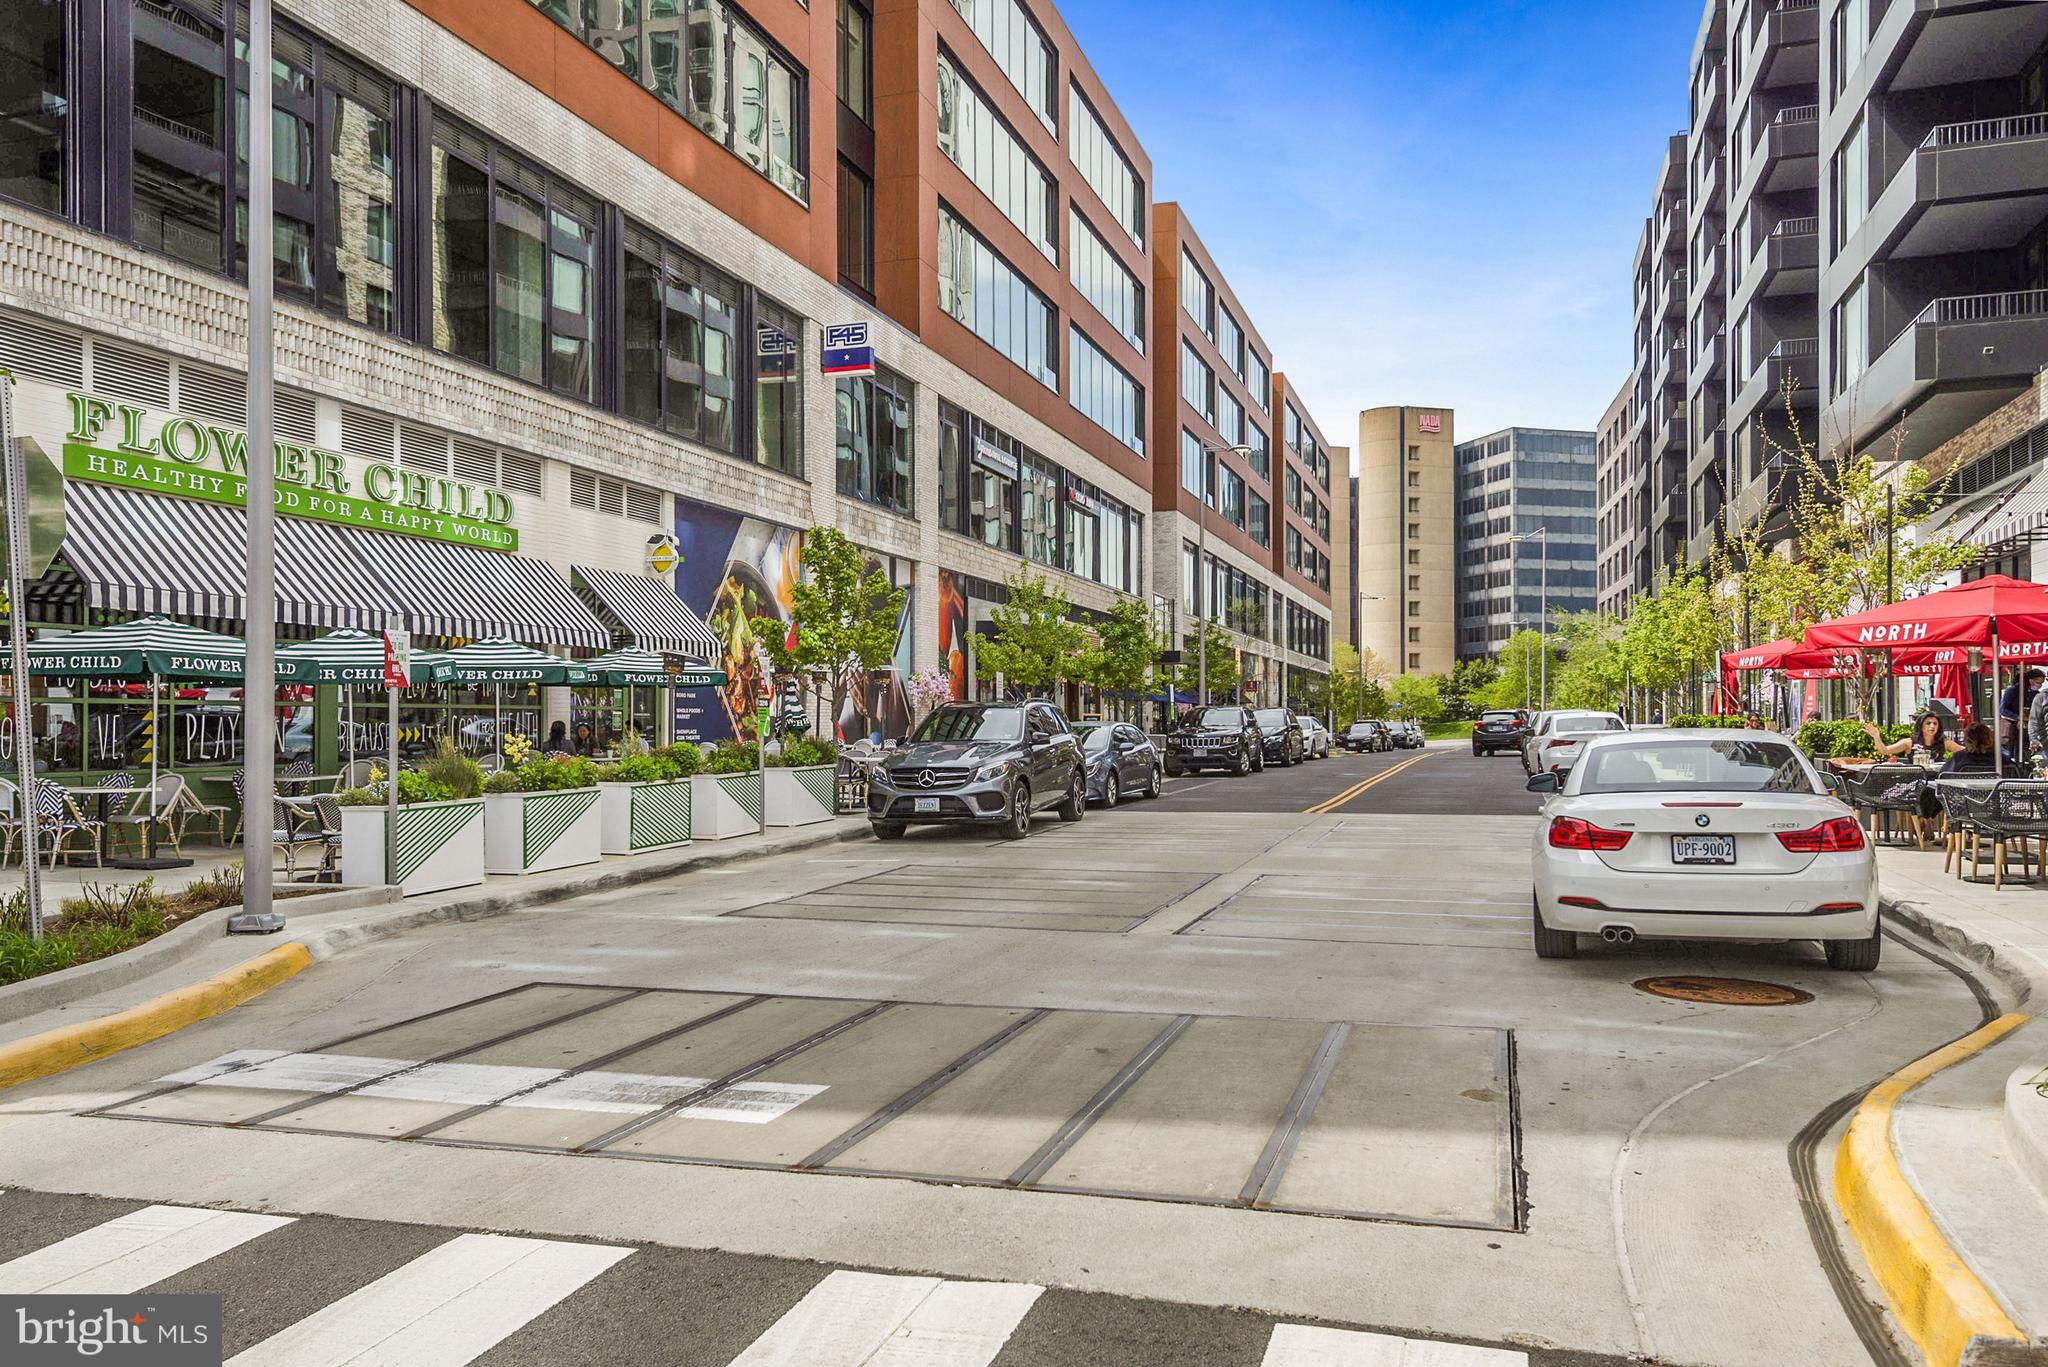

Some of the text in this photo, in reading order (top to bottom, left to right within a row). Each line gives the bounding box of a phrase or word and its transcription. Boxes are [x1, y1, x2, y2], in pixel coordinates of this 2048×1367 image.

[827, 323, 867, 346] F45
[1419, 414, 1440, 427] NADA
[66, 392, 515, 525] FLOWER CHILD
[87, 455, 514, 545] HEALTHY FOD FOR A HAPPY WORLD
[1859, 622, 1927, 643] NORTH
[70, 656, 122, 669] CHILD
[171, 656, 242, 673] FLOWER
[1739, 655, 1764, 667] NORTH
[491, 669, 543, 679] CHILD
[675, 674, 711, 684] CHILD
[186, 712, 240, 761] PLAY
[1677, 842, 1732, 856] UPF-9002
